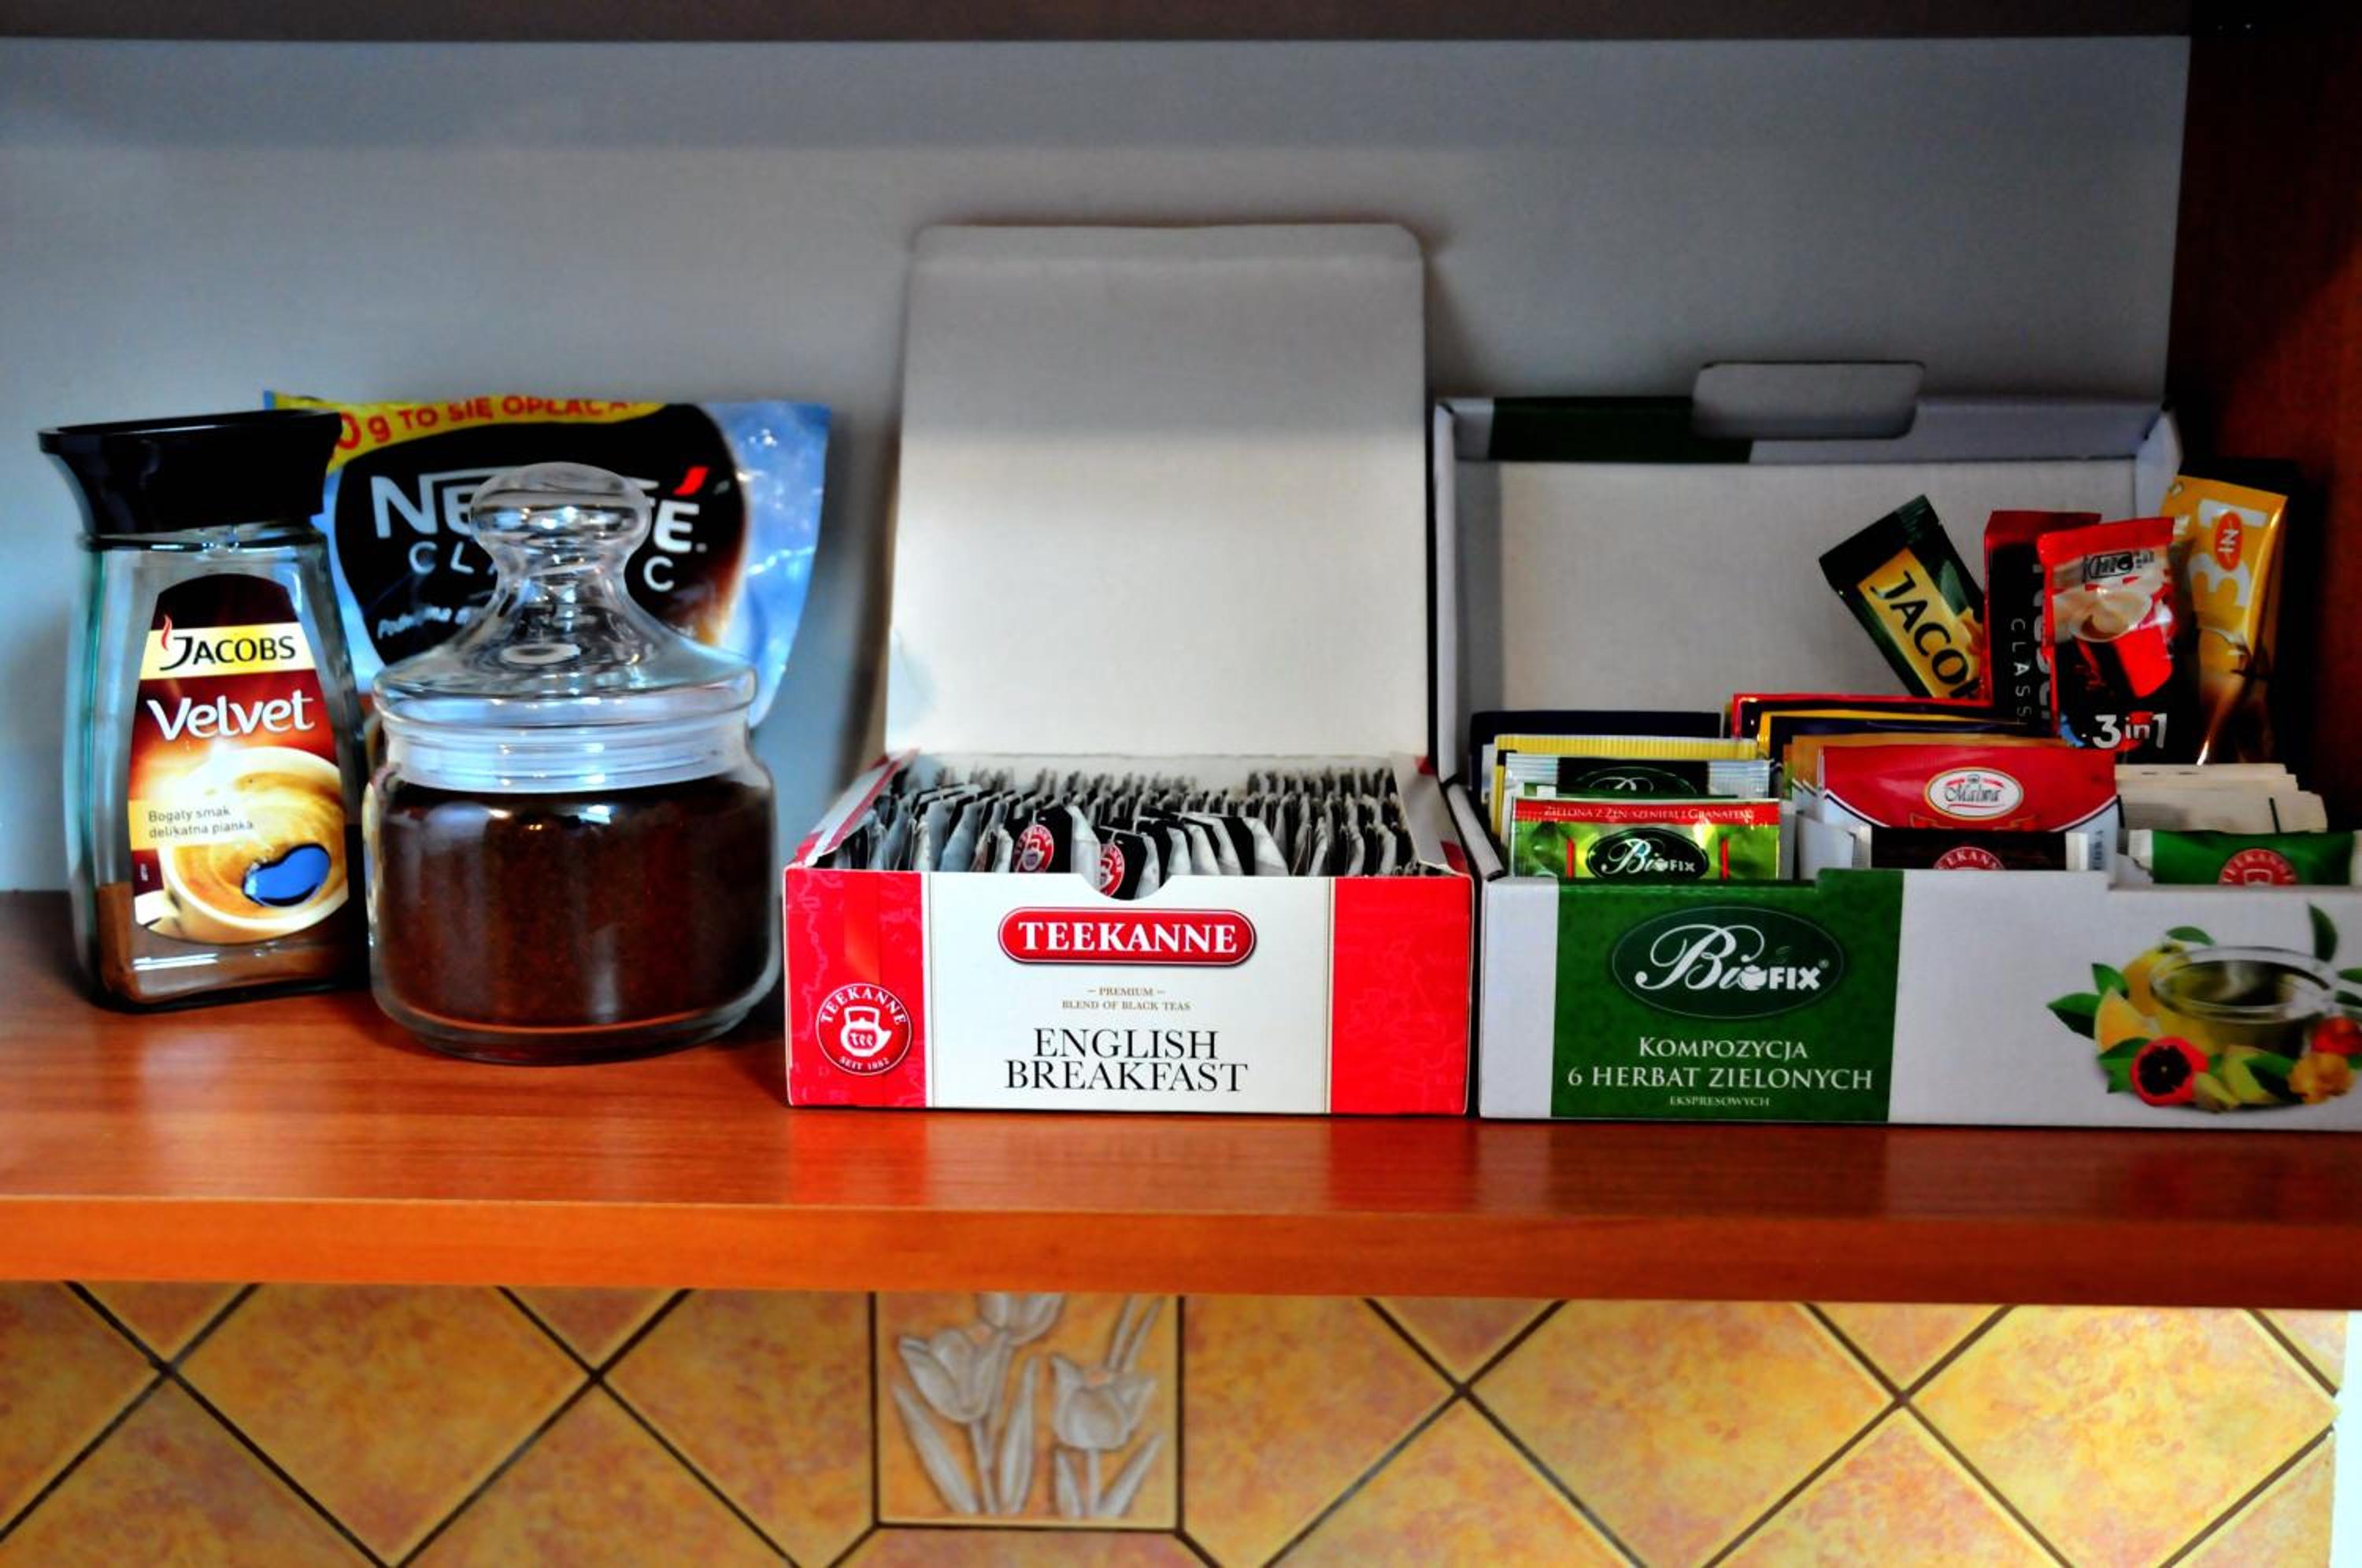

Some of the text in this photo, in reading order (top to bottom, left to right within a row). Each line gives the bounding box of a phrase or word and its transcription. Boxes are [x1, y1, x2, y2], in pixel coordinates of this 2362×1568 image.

[398, 408, 439, 429] TO
[160, 636, 296, 671] JACOBS
[146, 690, 315, 741] Velvet
[2092, 711, 2168, 749] 3in1
[148, 806, 231, 823] Bogaty smak
[149, 823, 209, 838] delikatna
[1017, 920, 1238, 955] TEEKANNE
[820, 986, 908, 1025] TEEKANNE
[1061, 1000, 1192, 1011] BLEND OF BLACK TEAS
[1098, 986, 1154, 997] PREMIUM
[1034, 1028, 1220, 1060] ENGLISH
[1638, 1037, 1809, 1061] KOMPOZYCJA
[1005, 1061, 1249, 1094] BREAKFAST
[1568, 1067, 1874, 1090] 6 HERBAT ZIELONYCH
